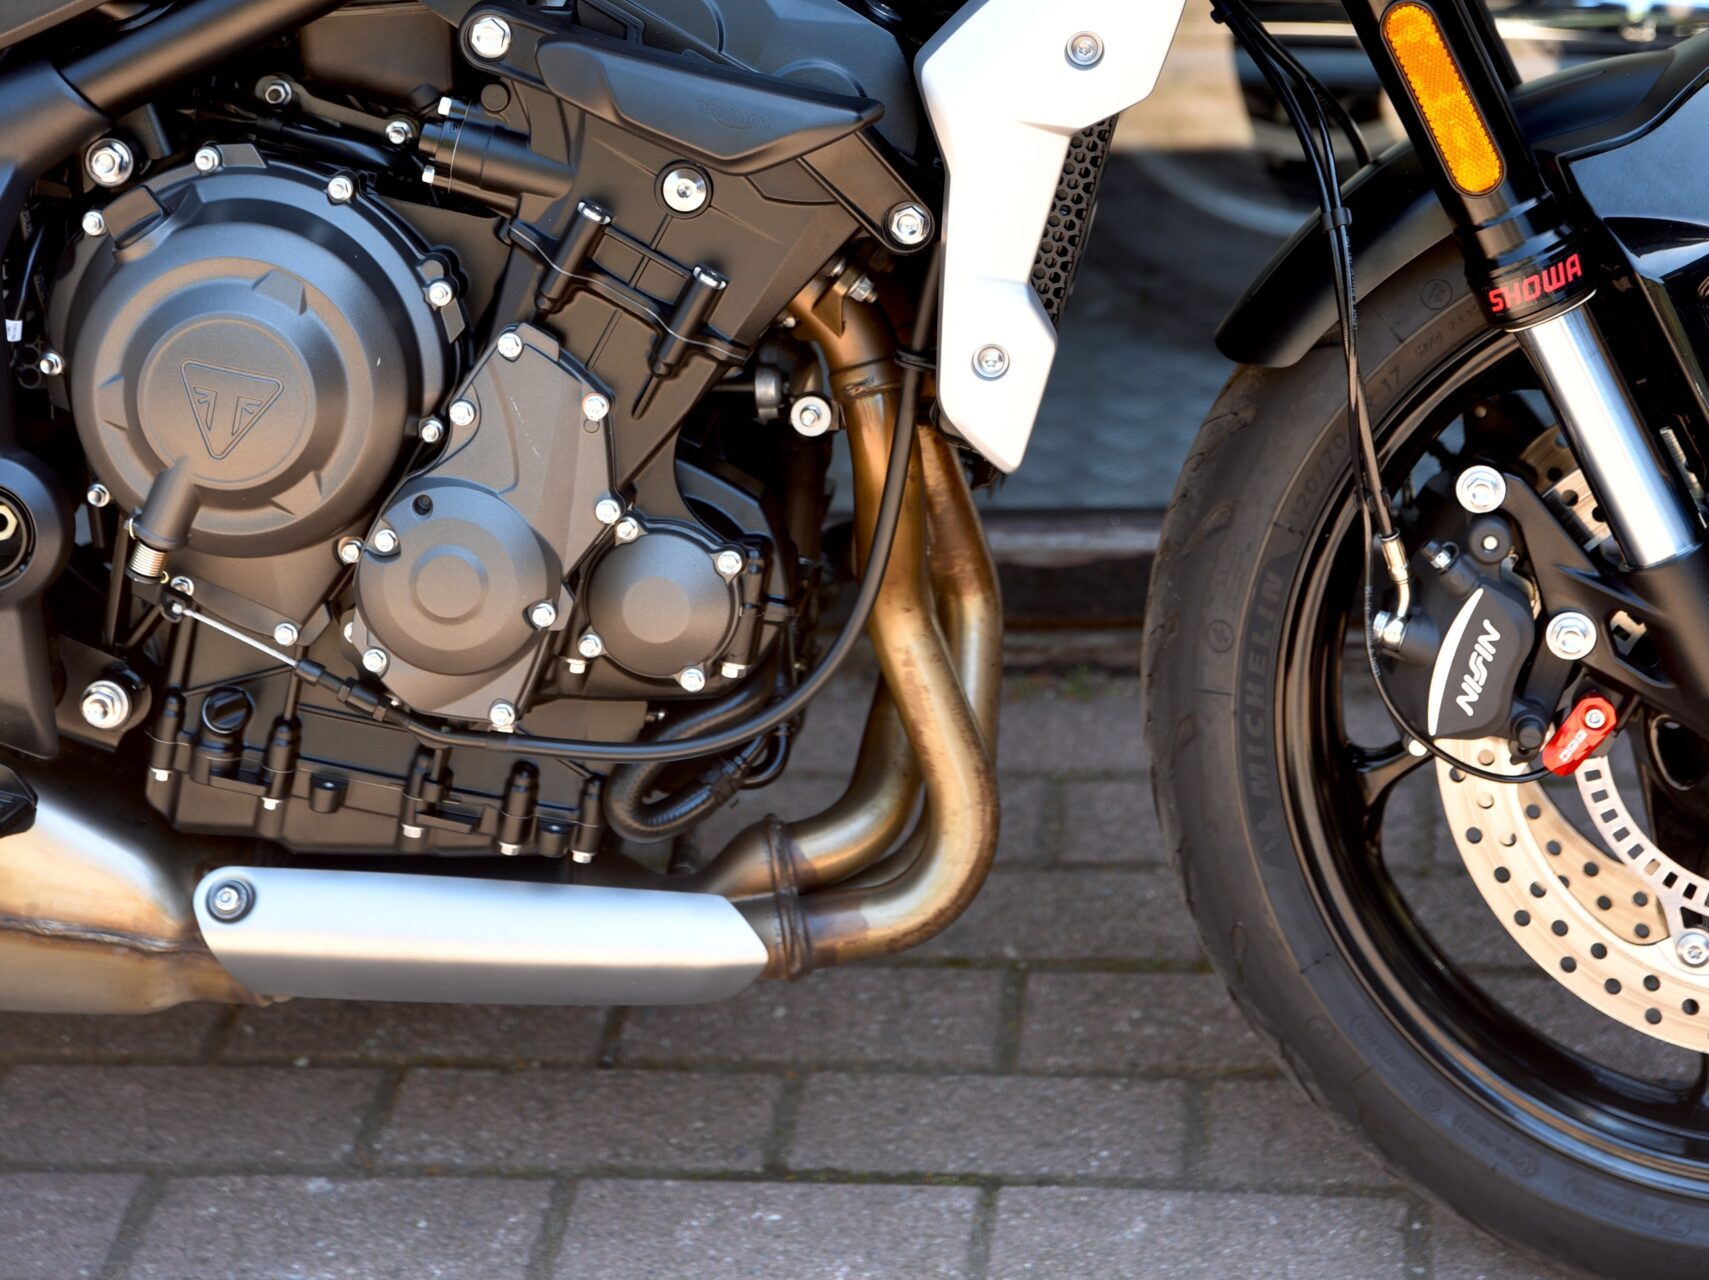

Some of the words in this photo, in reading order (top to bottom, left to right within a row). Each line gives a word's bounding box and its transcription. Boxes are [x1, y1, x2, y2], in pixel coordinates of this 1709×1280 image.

[1488, 253, 1583, 314] SHOWA
[1245, 571, 1284, 800] MICHELIN
[1456, 619, 1501, 717] NISSIN
